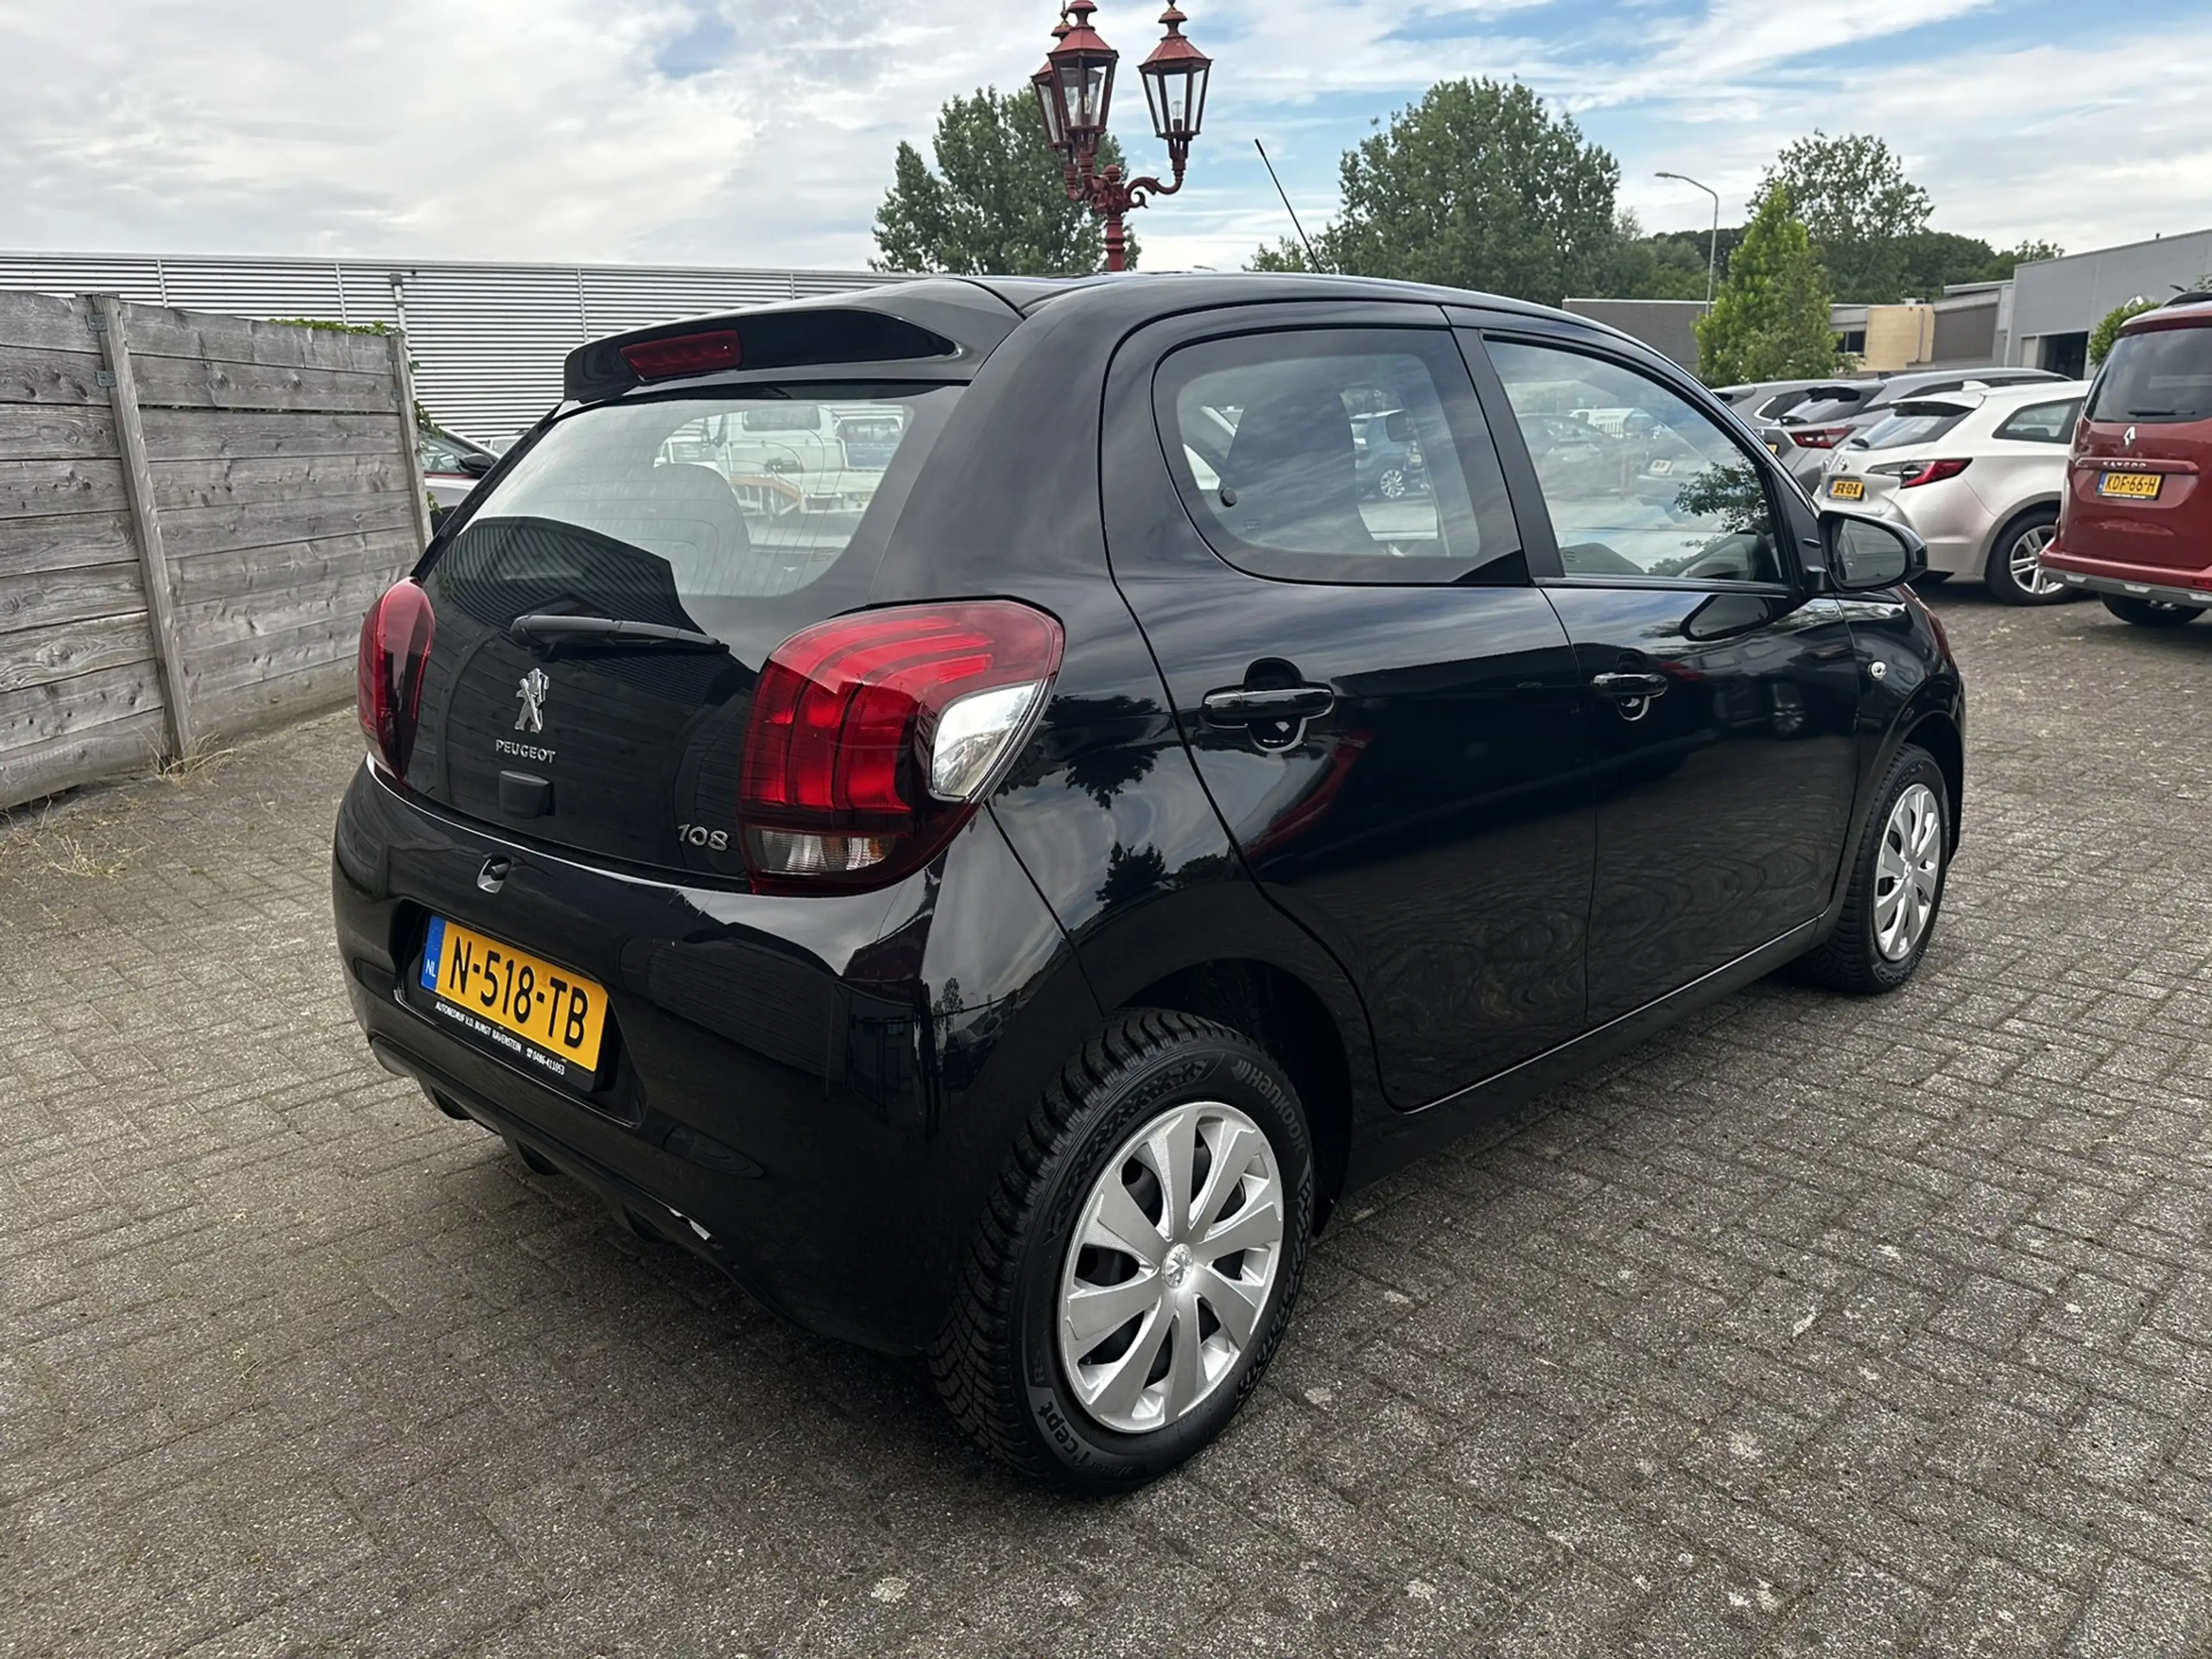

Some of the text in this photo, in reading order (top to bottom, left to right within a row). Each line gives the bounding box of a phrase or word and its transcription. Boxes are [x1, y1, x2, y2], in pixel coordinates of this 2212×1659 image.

[2105, 475, 2158, 493] KDF-66-H
[495, 739, 557, 763] PEUGEOT
[677, 824, 729, 851] 108
[425, 958, 437, 978] NL
[449, 935, 589, 1049] N-518-TB
